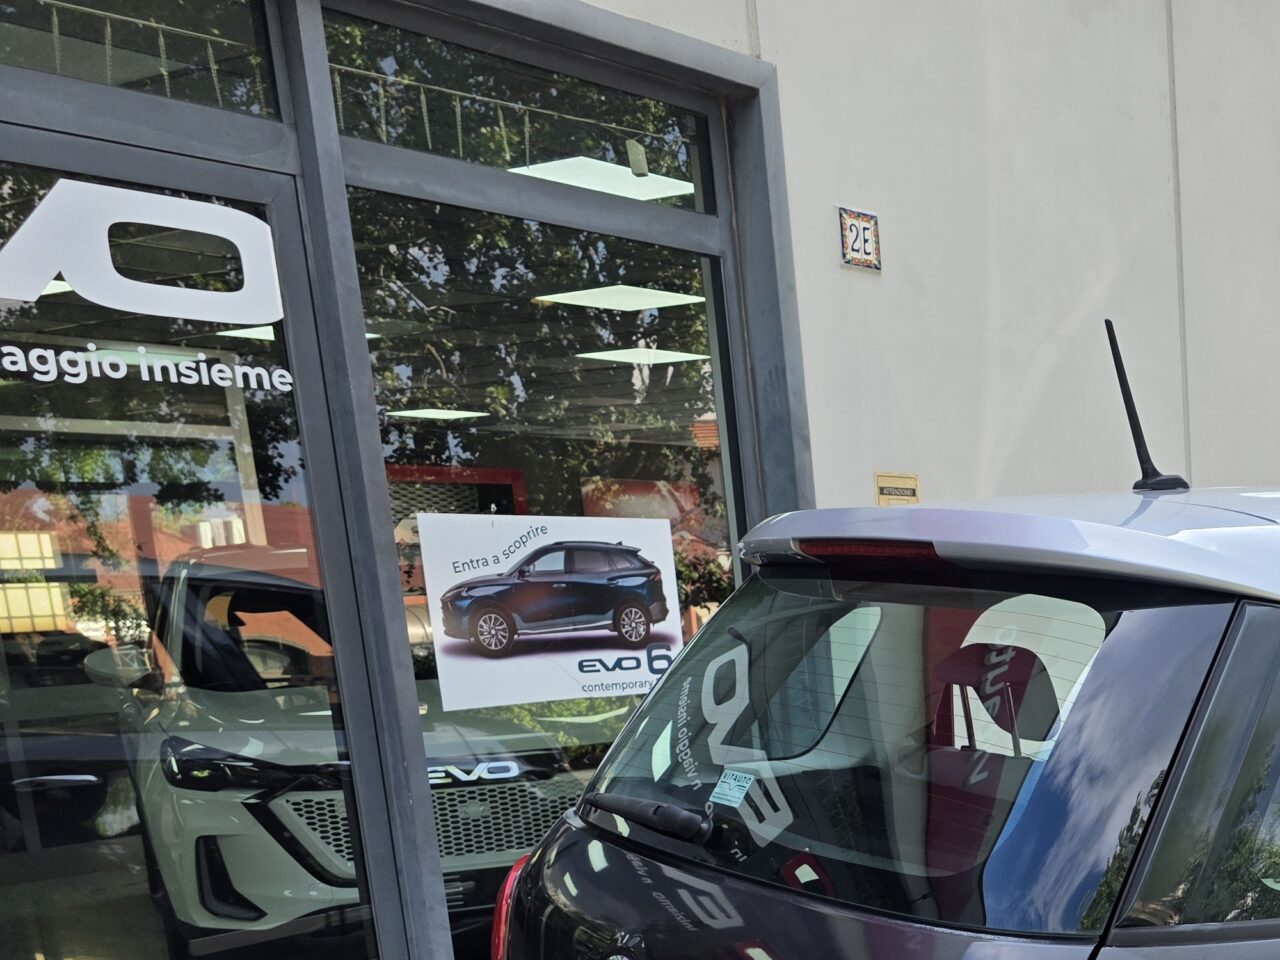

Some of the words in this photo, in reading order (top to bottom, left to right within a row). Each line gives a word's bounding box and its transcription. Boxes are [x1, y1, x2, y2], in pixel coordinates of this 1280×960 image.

[849, 223, 872, 256] 2E
[0, 342, 128, 384] aggio
[138, 346, 294, 392] insieme
[452, 556, 489, 574] Entra
[493, 554, 501, 565] a
[502, 524, 549, 560] scoprire
[578, 656, 641, 674] EVO
[647, 643, 673, 676] 6
[582, 678, 654, 694] contemporary
[427, 761, 520, 784] EVO
[723, 771, 752, 785] VITAUTO
